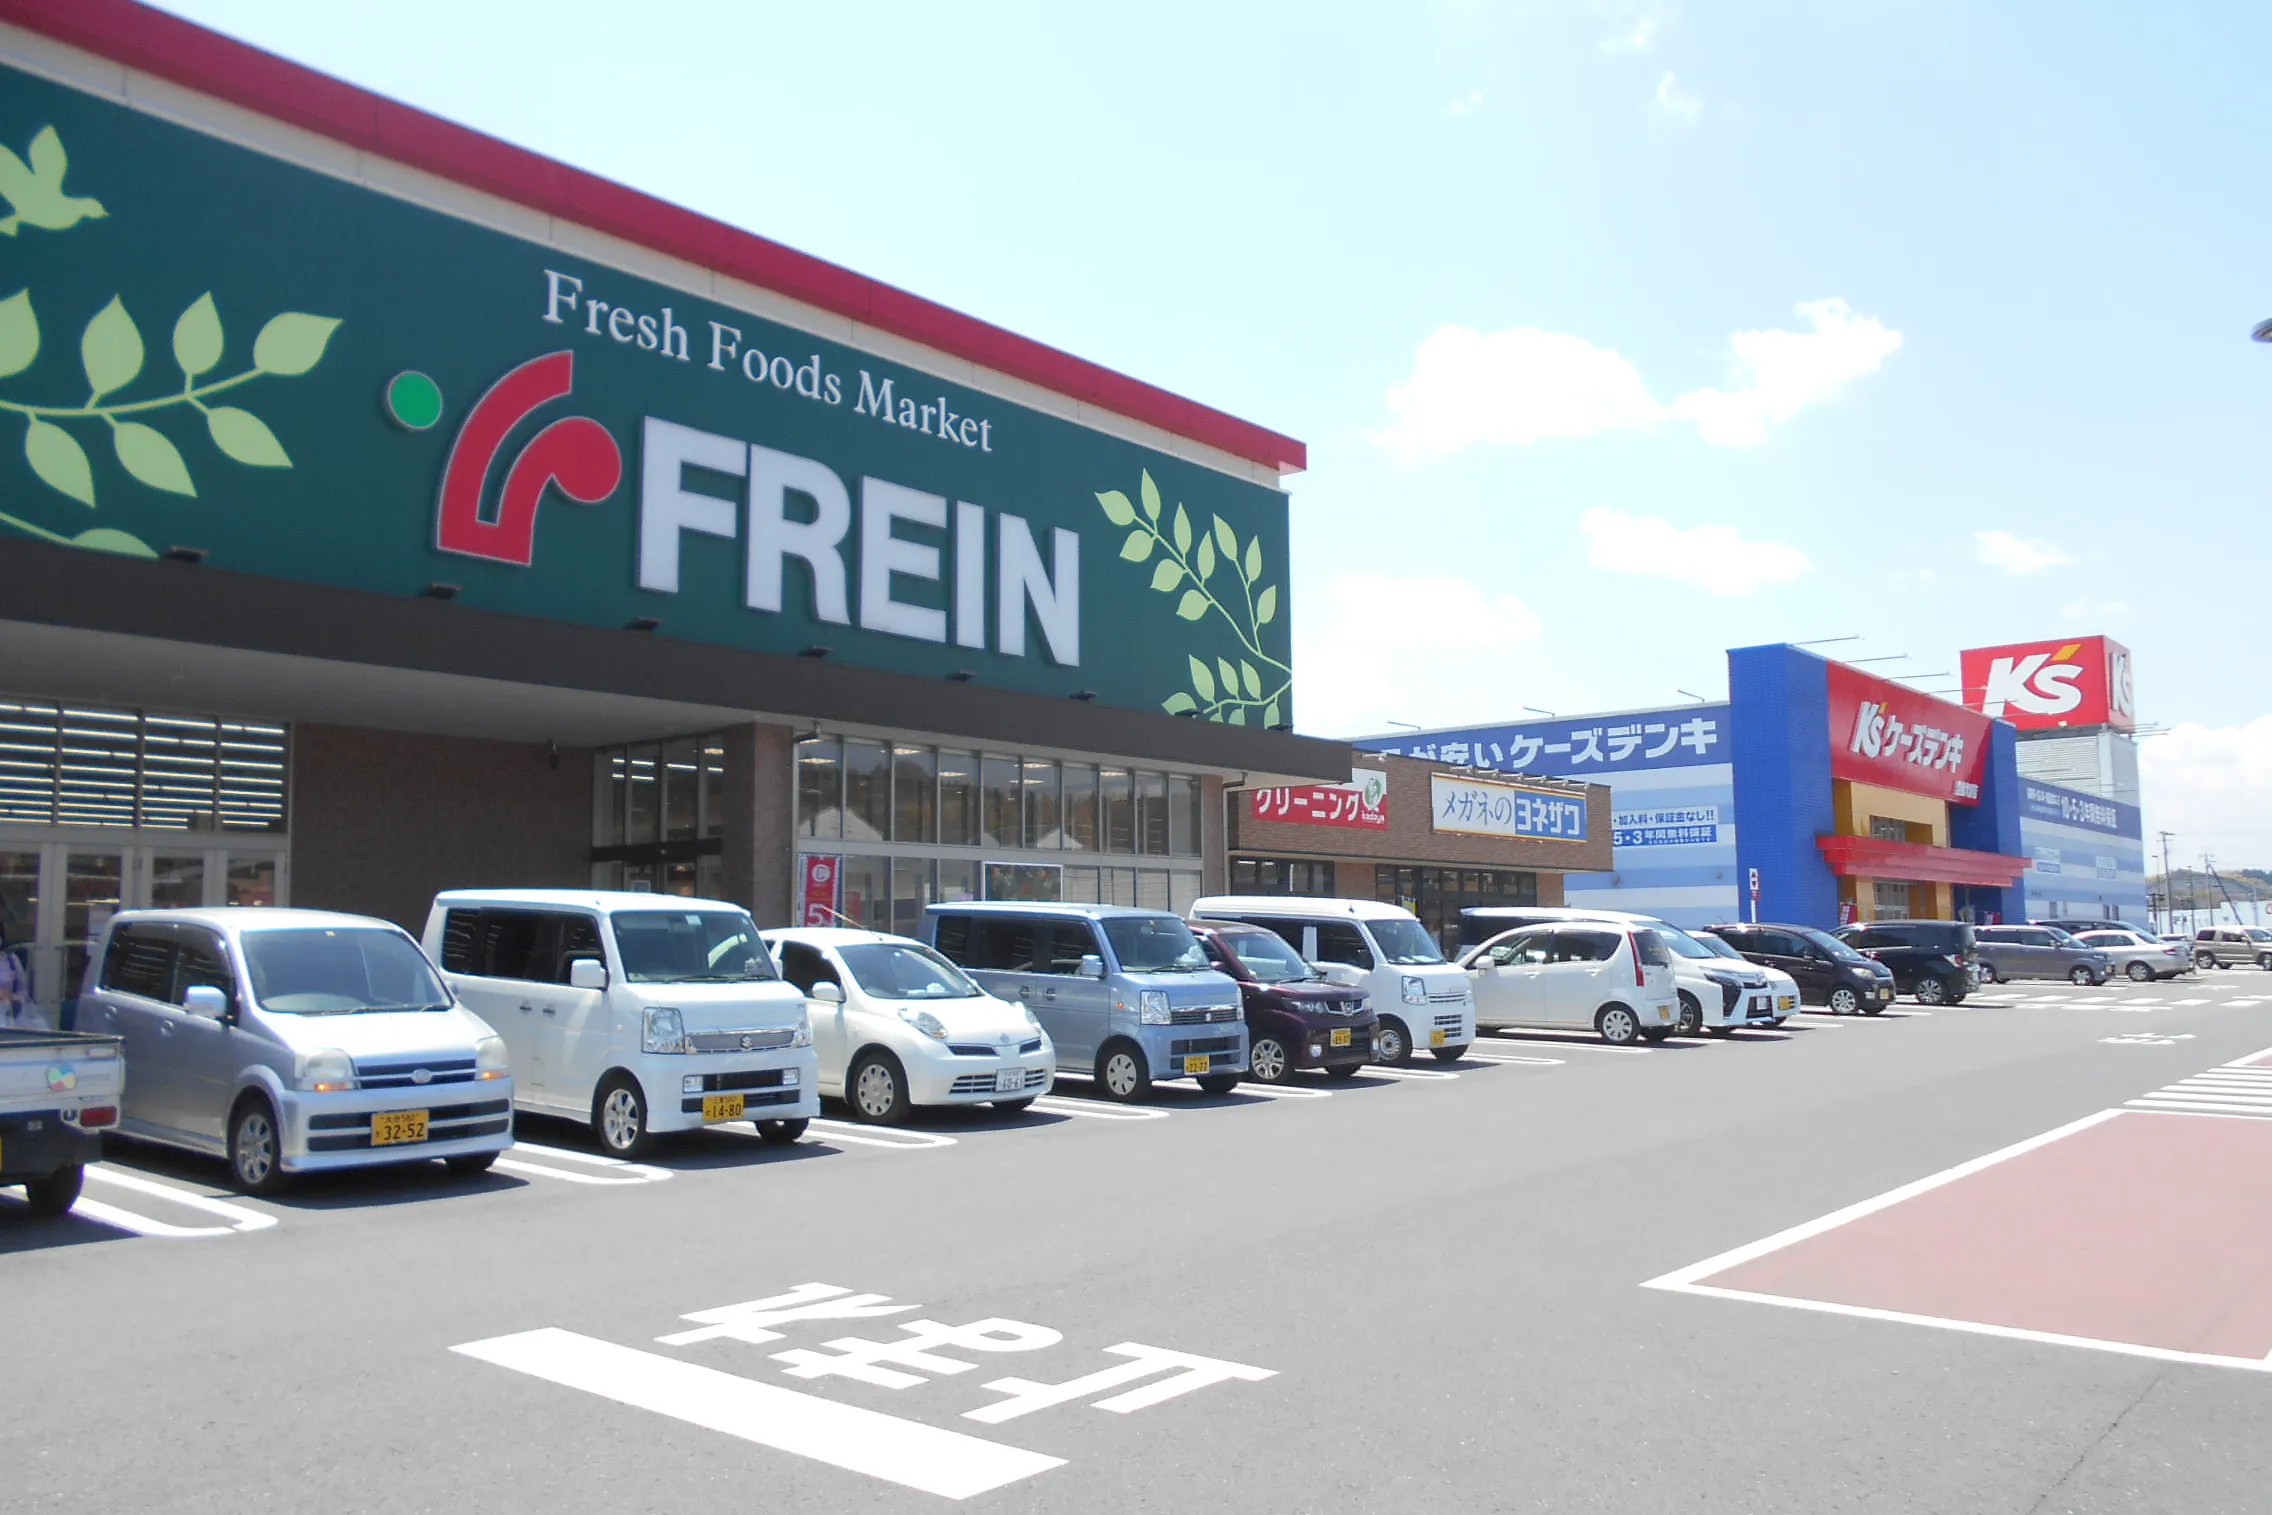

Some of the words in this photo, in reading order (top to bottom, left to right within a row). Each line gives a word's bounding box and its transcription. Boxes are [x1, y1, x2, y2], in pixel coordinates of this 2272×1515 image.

[543, 268, 692, 362] Fresh
[706, 321, 843, 405] Foods
[853, 369, 993, 452] Market
[637, 415, 1079, 667] FREIN
[1257, 788, 1360, 822] クリーニング
[1442, 790, 1513, 826] メガネの
[1516, 797, 1580, 836] ヨネザワ
[383, 1122, 425, 1141] 32-52
